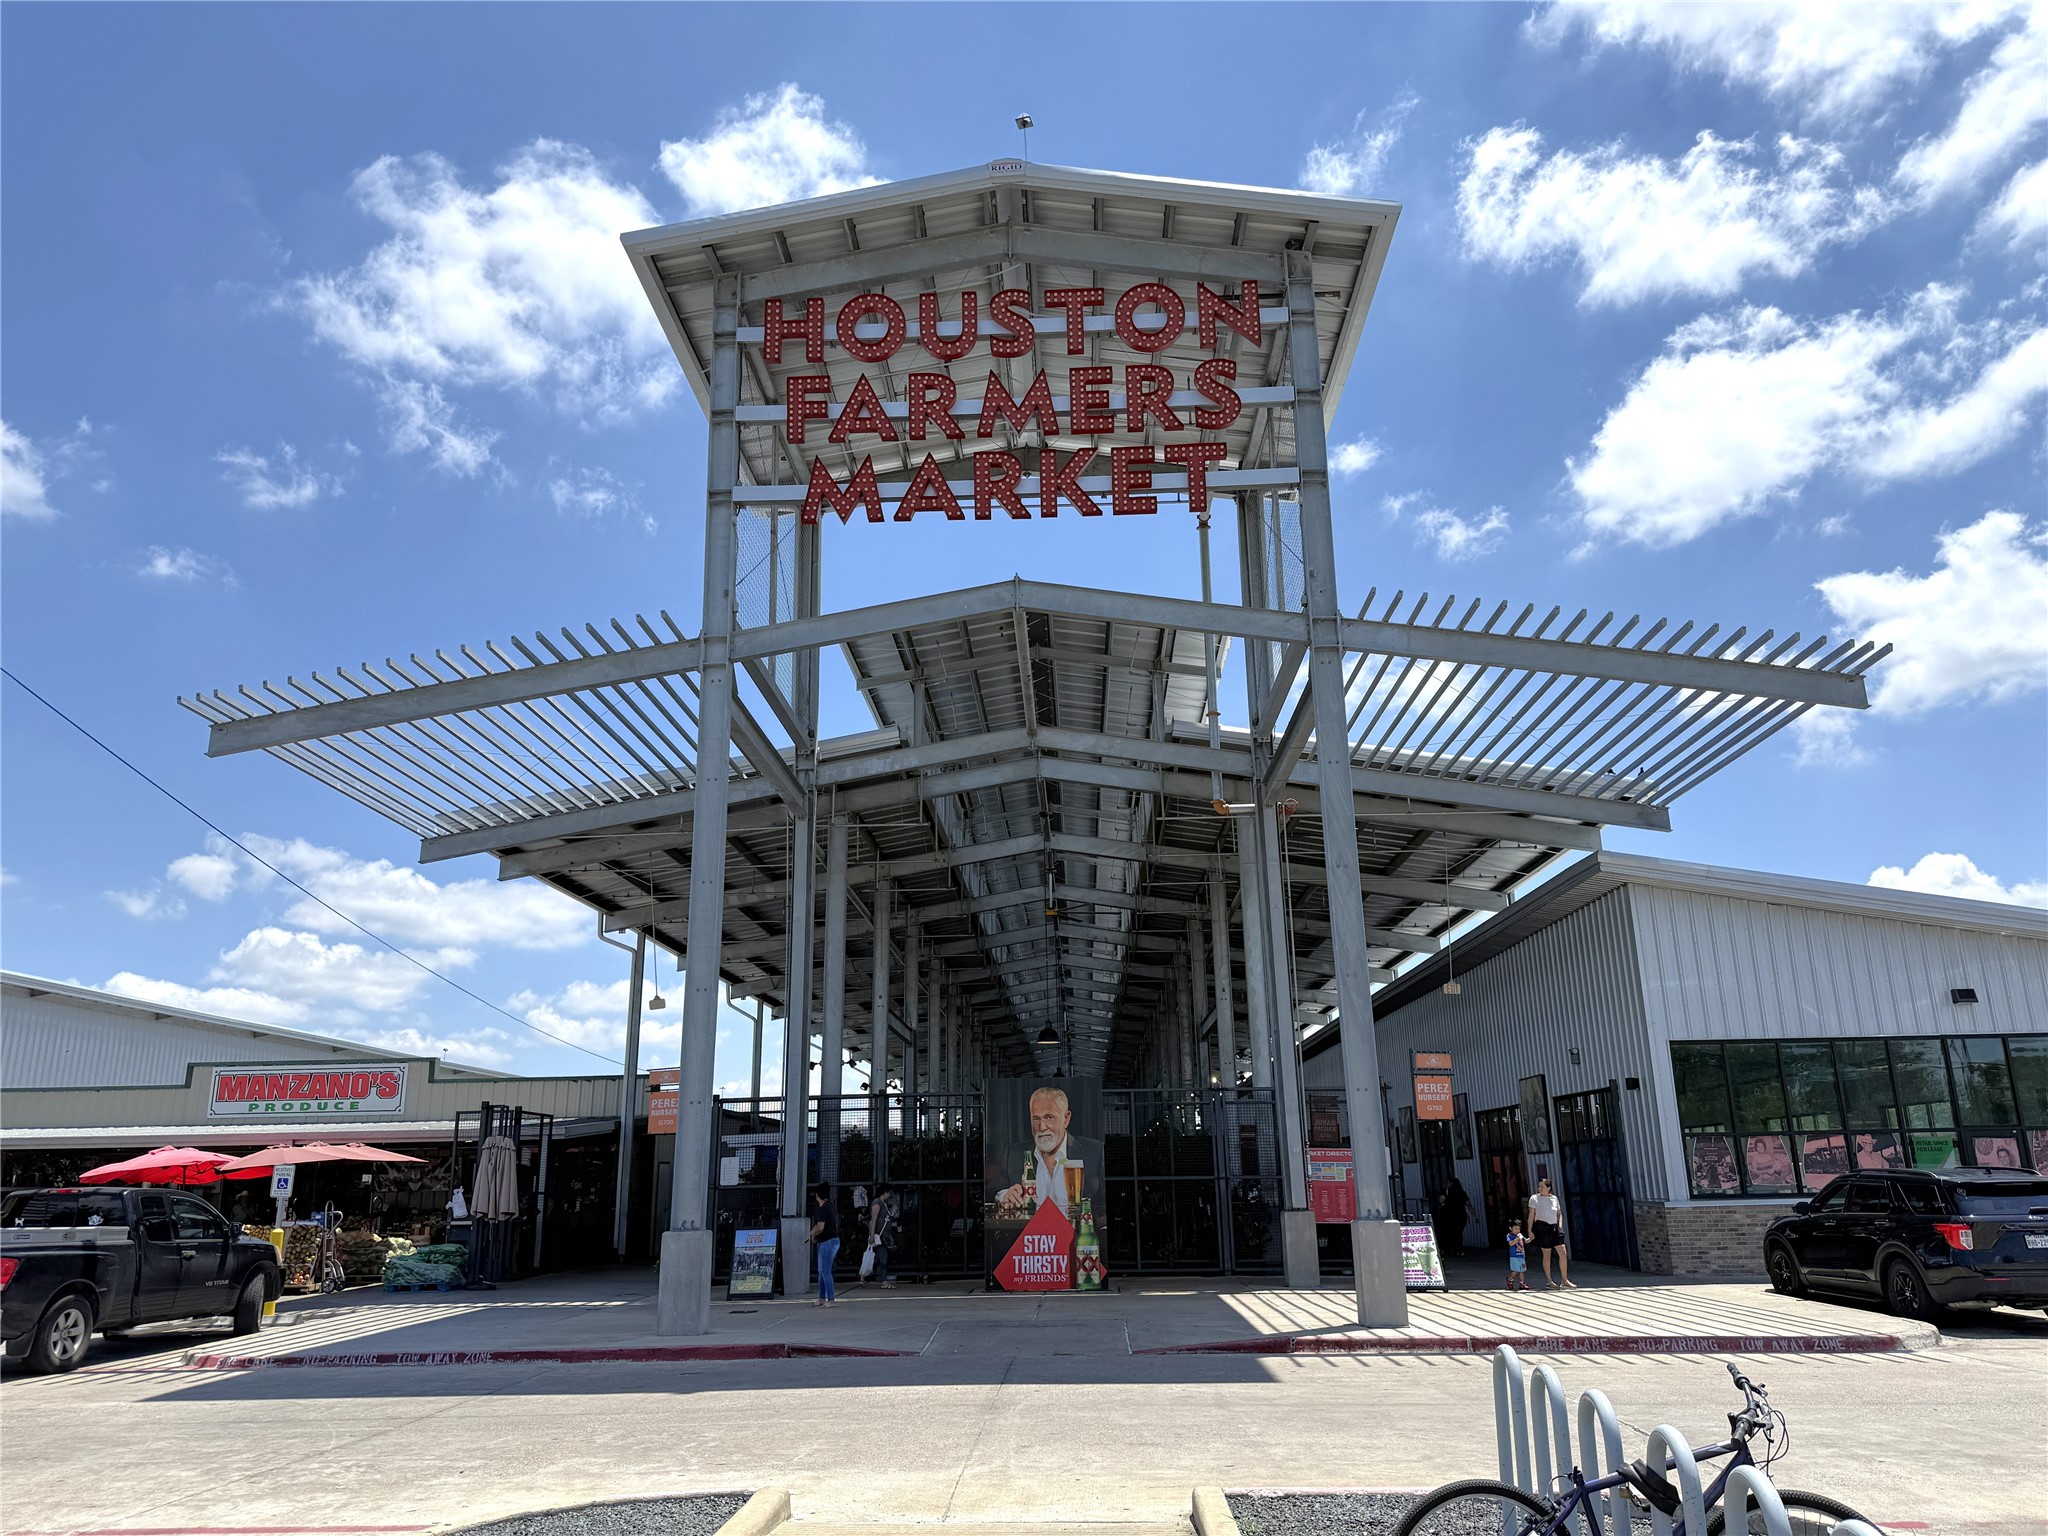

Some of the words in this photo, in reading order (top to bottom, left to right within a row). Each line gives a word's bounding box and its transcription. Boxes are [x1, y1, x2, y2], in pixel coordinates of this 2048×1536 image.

[764, 280, 1262, 364] HOUSTON
[786, 359, 1242, 445] FARMERS
[801, 442, 1227, 526] MARKET
[216, 1071, 401, 1102] MANZANO'S
[1417, 1083, 1449, 1093] PEREZ
[248, 1101, 360, 1112] PRODUCE
[651, 1098, 678, 1108] PERE
[651, 1109, 678, 1117] NURSER
[1024, 1235, 1056, 1253] STAY
[1013, 1255, 1068, 1274] THIRSTY
[1536, 1338, 1566, 1351] FIRE
[1571, 1338, 1609, 1351] LANE
[1638, 1339, 1655, 1350] NO
[1662, 1338, 1719, 1351] PARKING
[1741, 1339, 1764, 1350] TOW
[1772, 1339, 1805, 1351] AWAY
[1812, 1338, 1845, 1350] ZONE
[216, 1357, 238, 1368] FIRE
[244, 1357, 276, 1367] LANE
[303, 1356, 319, 1365] NO
[326, 1353, 379, 1366] PARKING
[397, 1353, 420, 1363] TOW
[425, 1353, 458, 1365] AWAY
[463, 1351, 492, 1363] ZONE
